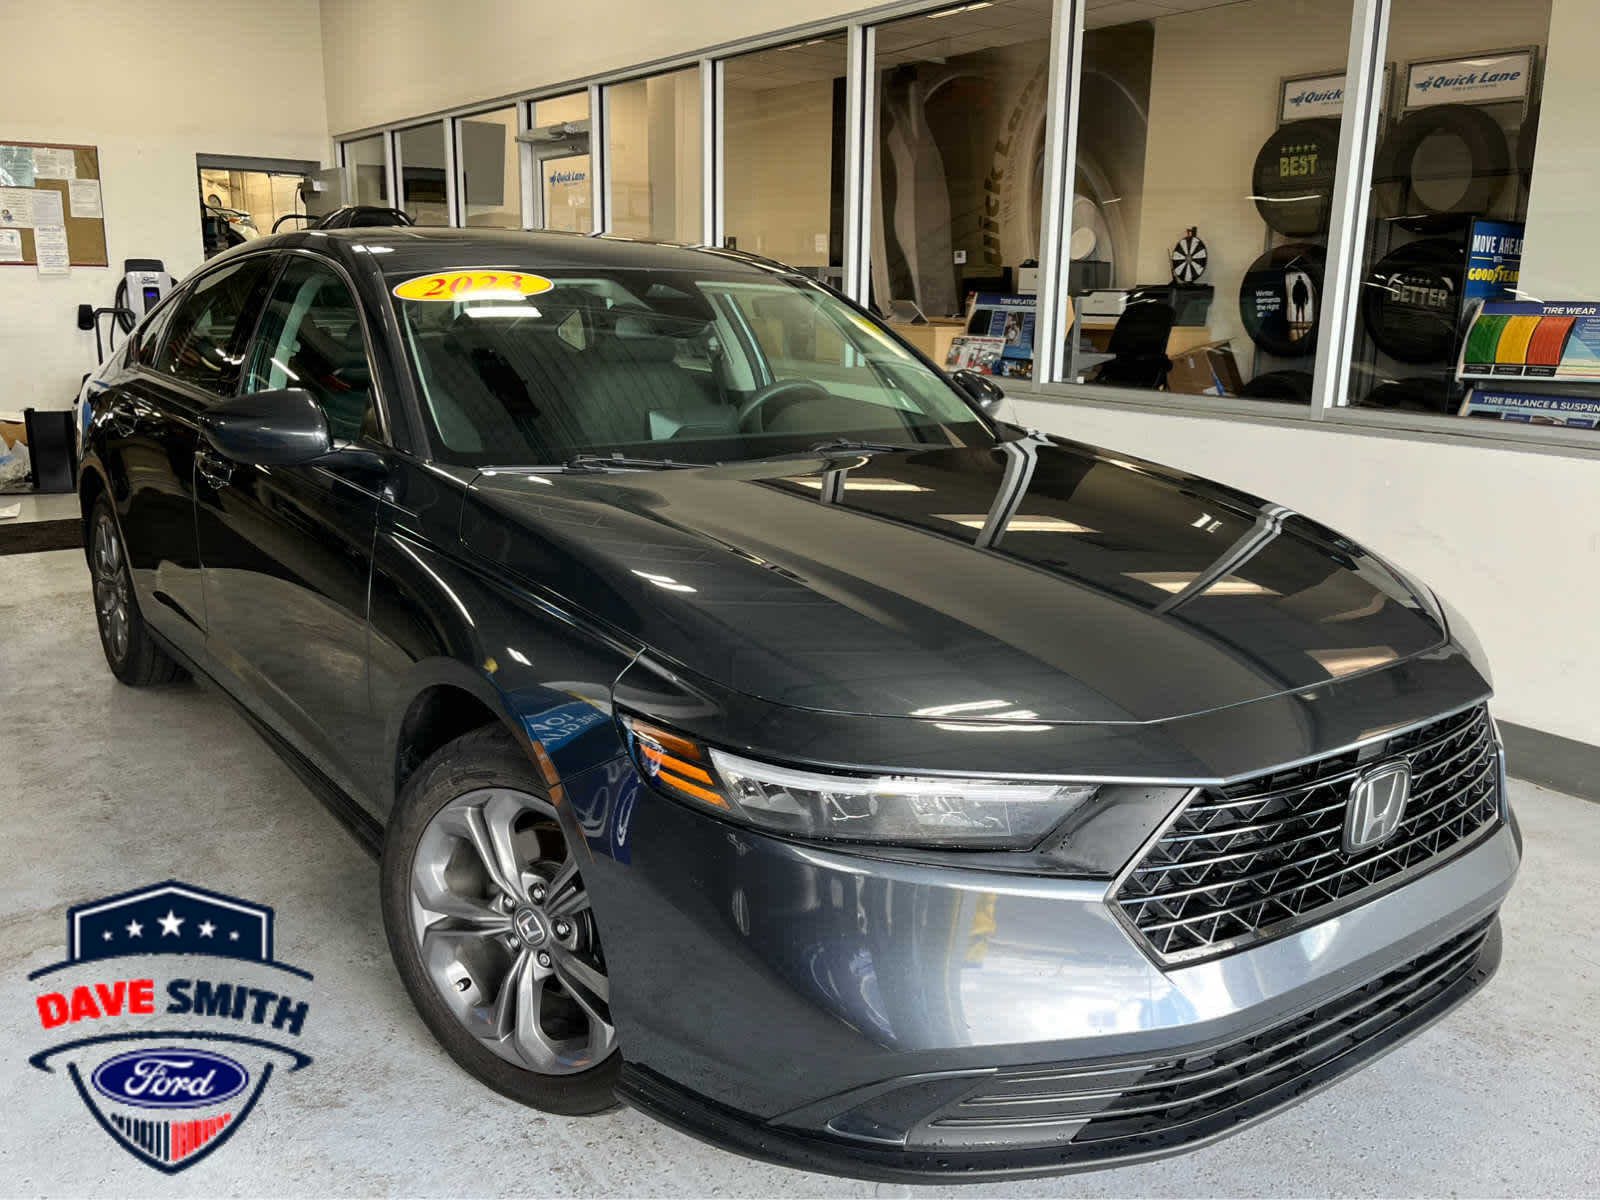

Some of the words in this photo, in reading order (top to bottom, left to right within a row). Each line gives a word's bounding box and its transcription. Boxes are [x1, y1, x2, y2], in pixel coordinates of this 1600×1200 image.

[1433, 73, 1478, 88] Quick
[1479, 71, 1521, 84] Lane
[1304, 88, 1343, 104] Quick
[1279, 154, 1318, 177] BEST
[556, 171, 571, 184] Quick
[571, 171, 586, 181] Lane
[1472, 234, 1497, 253] MOVE
[423, 274, 523, 297] 2023
[1390, 284, 1449, 307] BETTER
[1542, 306, 1565, 315] TIRE
[1566, 306, 1597, 315] WEAR
[1483, 396, 1505, 405] TIRE
[1504, 397, 1551, 409] BALANCE
[1550, 400, 1558, 409] &
